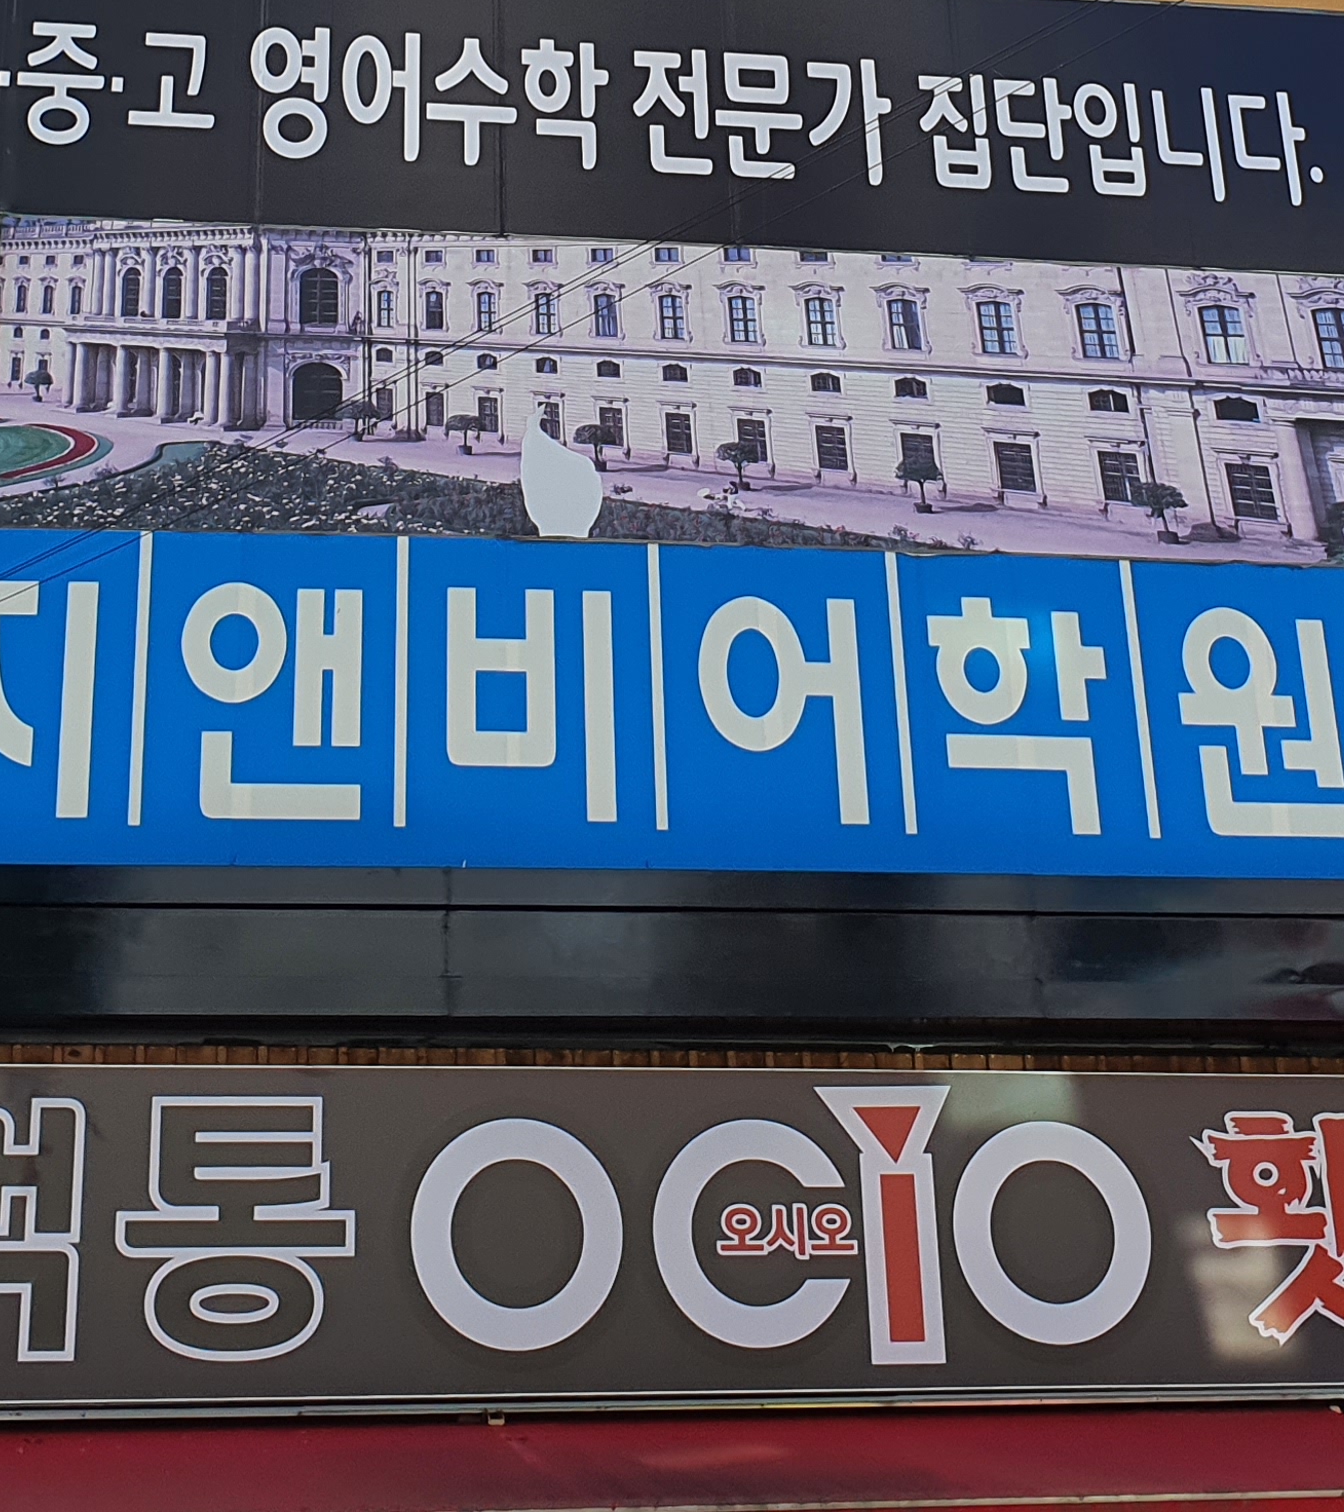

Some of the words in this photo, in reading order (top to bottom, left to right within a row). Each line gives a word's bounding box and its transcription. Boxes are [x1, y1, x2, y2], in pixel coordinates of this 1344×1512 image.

[250, 24, 610, 171] 영어수학
[632, 46, 892, 187] 전문가
[917, 72, 1325, 208] 집단입니다.
[717, 1201, 858, 1260] 오시오
